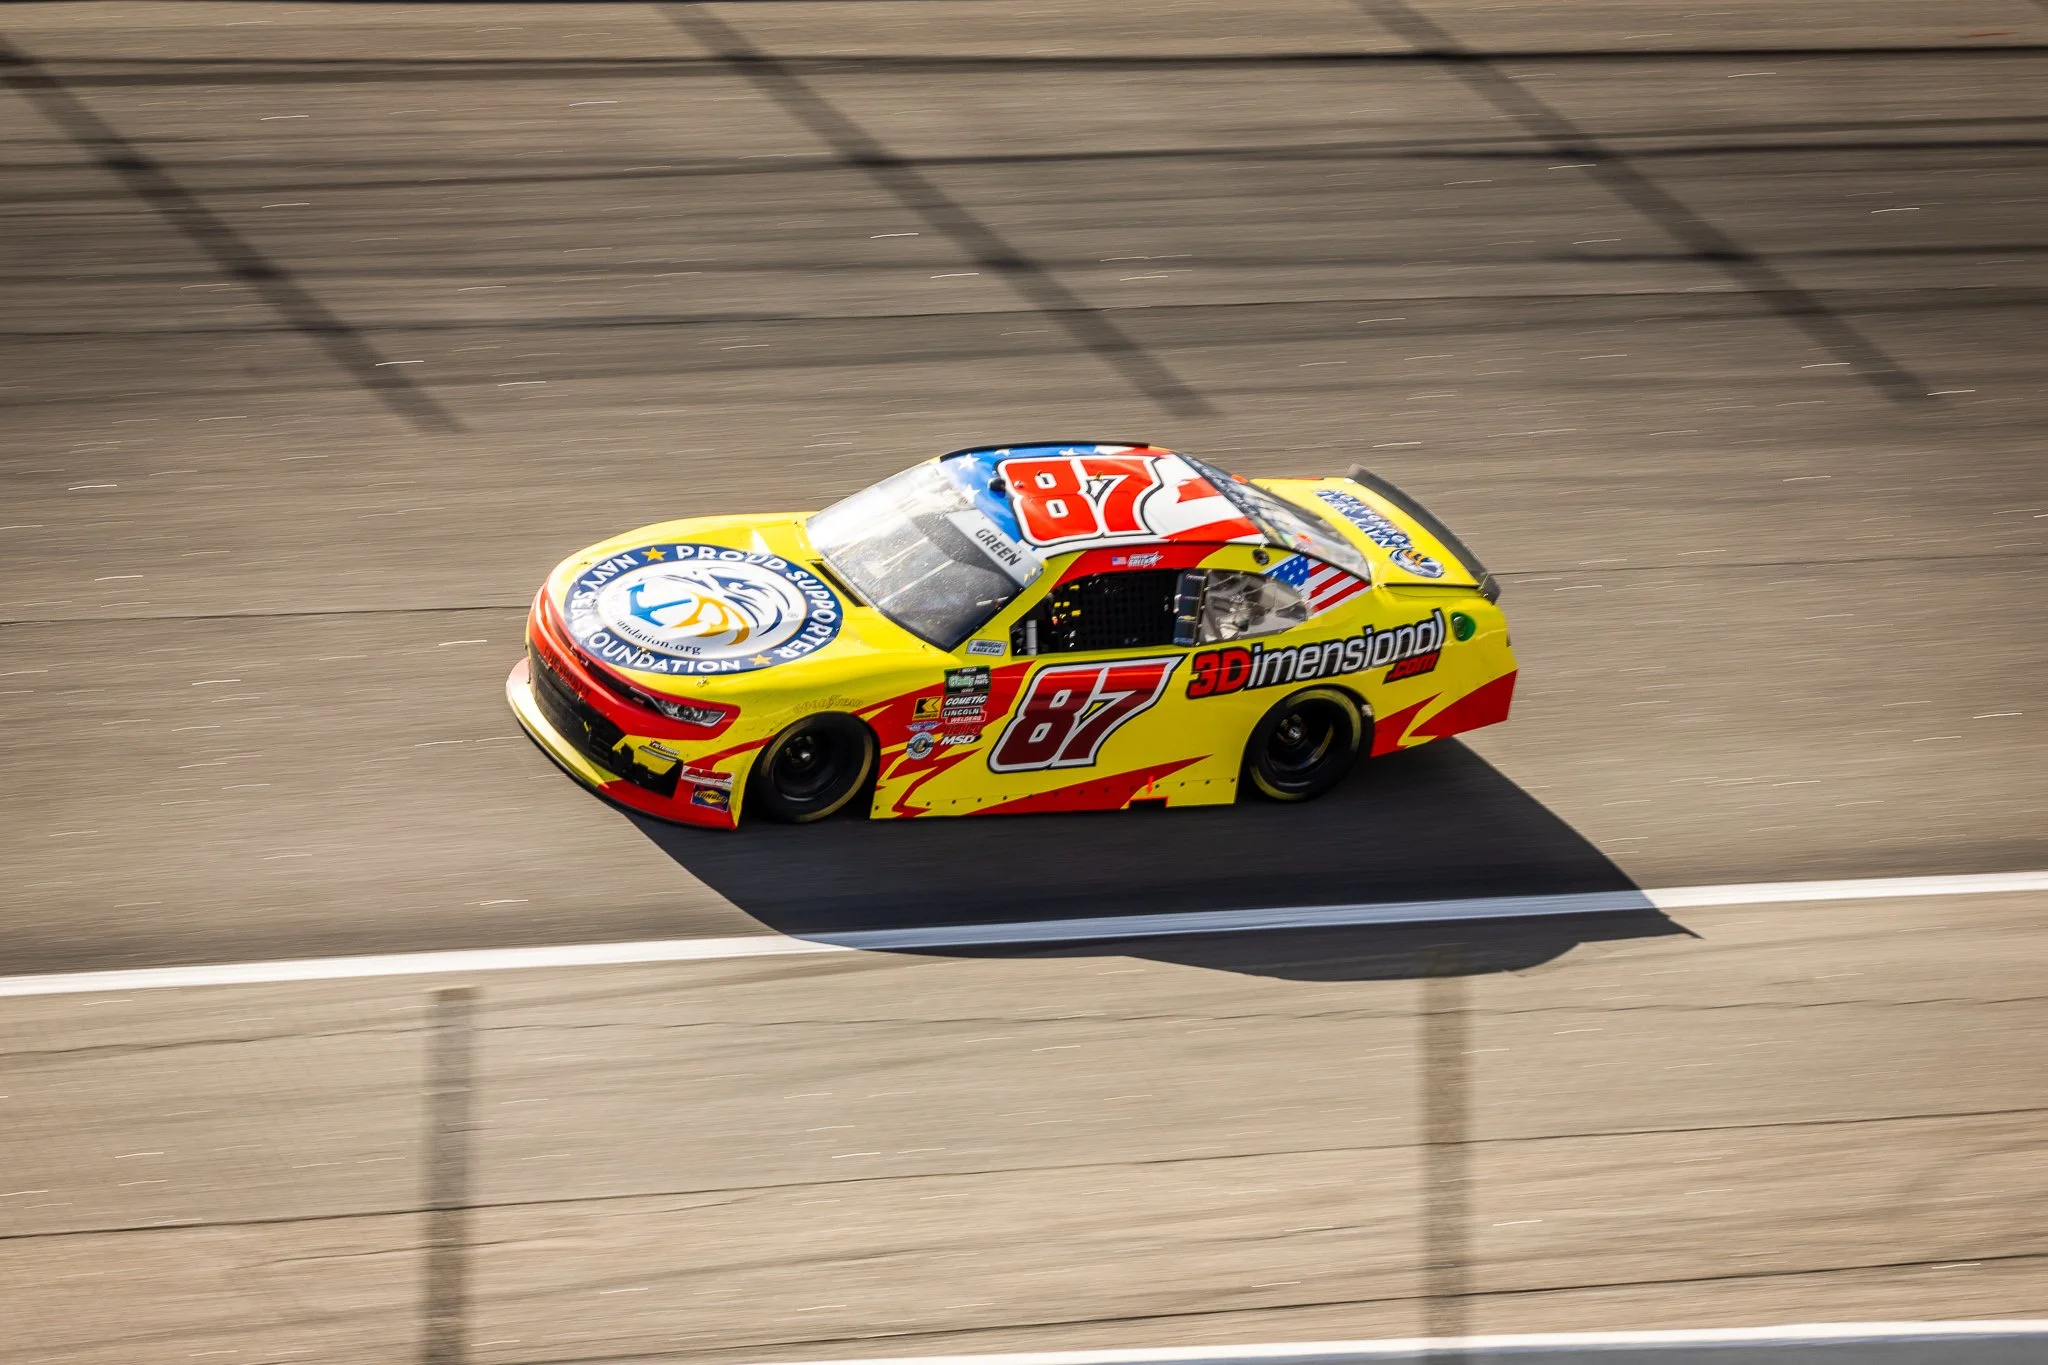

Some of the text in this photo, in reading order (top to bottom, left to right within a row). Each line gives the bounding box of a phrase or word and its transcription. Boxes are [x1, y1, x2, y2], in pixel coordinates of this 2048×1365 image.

[999, 456, 1161, 546] 87
[975, 528, 1022, 566] GREEN
[580, 553, 639, 591] NAVY
[675, 545, 838, 660] PROUD SUPPORTER
[577, 628, 741, 674] OUNDATION
[1188, 610, 1445, 697] 3Dimensional
[1388, 654, 1438, 680] .com
[943, 708, 980, 717] LINCOLN
[988, 654, 1187, 773] 87
[940, 734, 977, 746] MSD
[694, 789, 728, 804] SUNOCO
